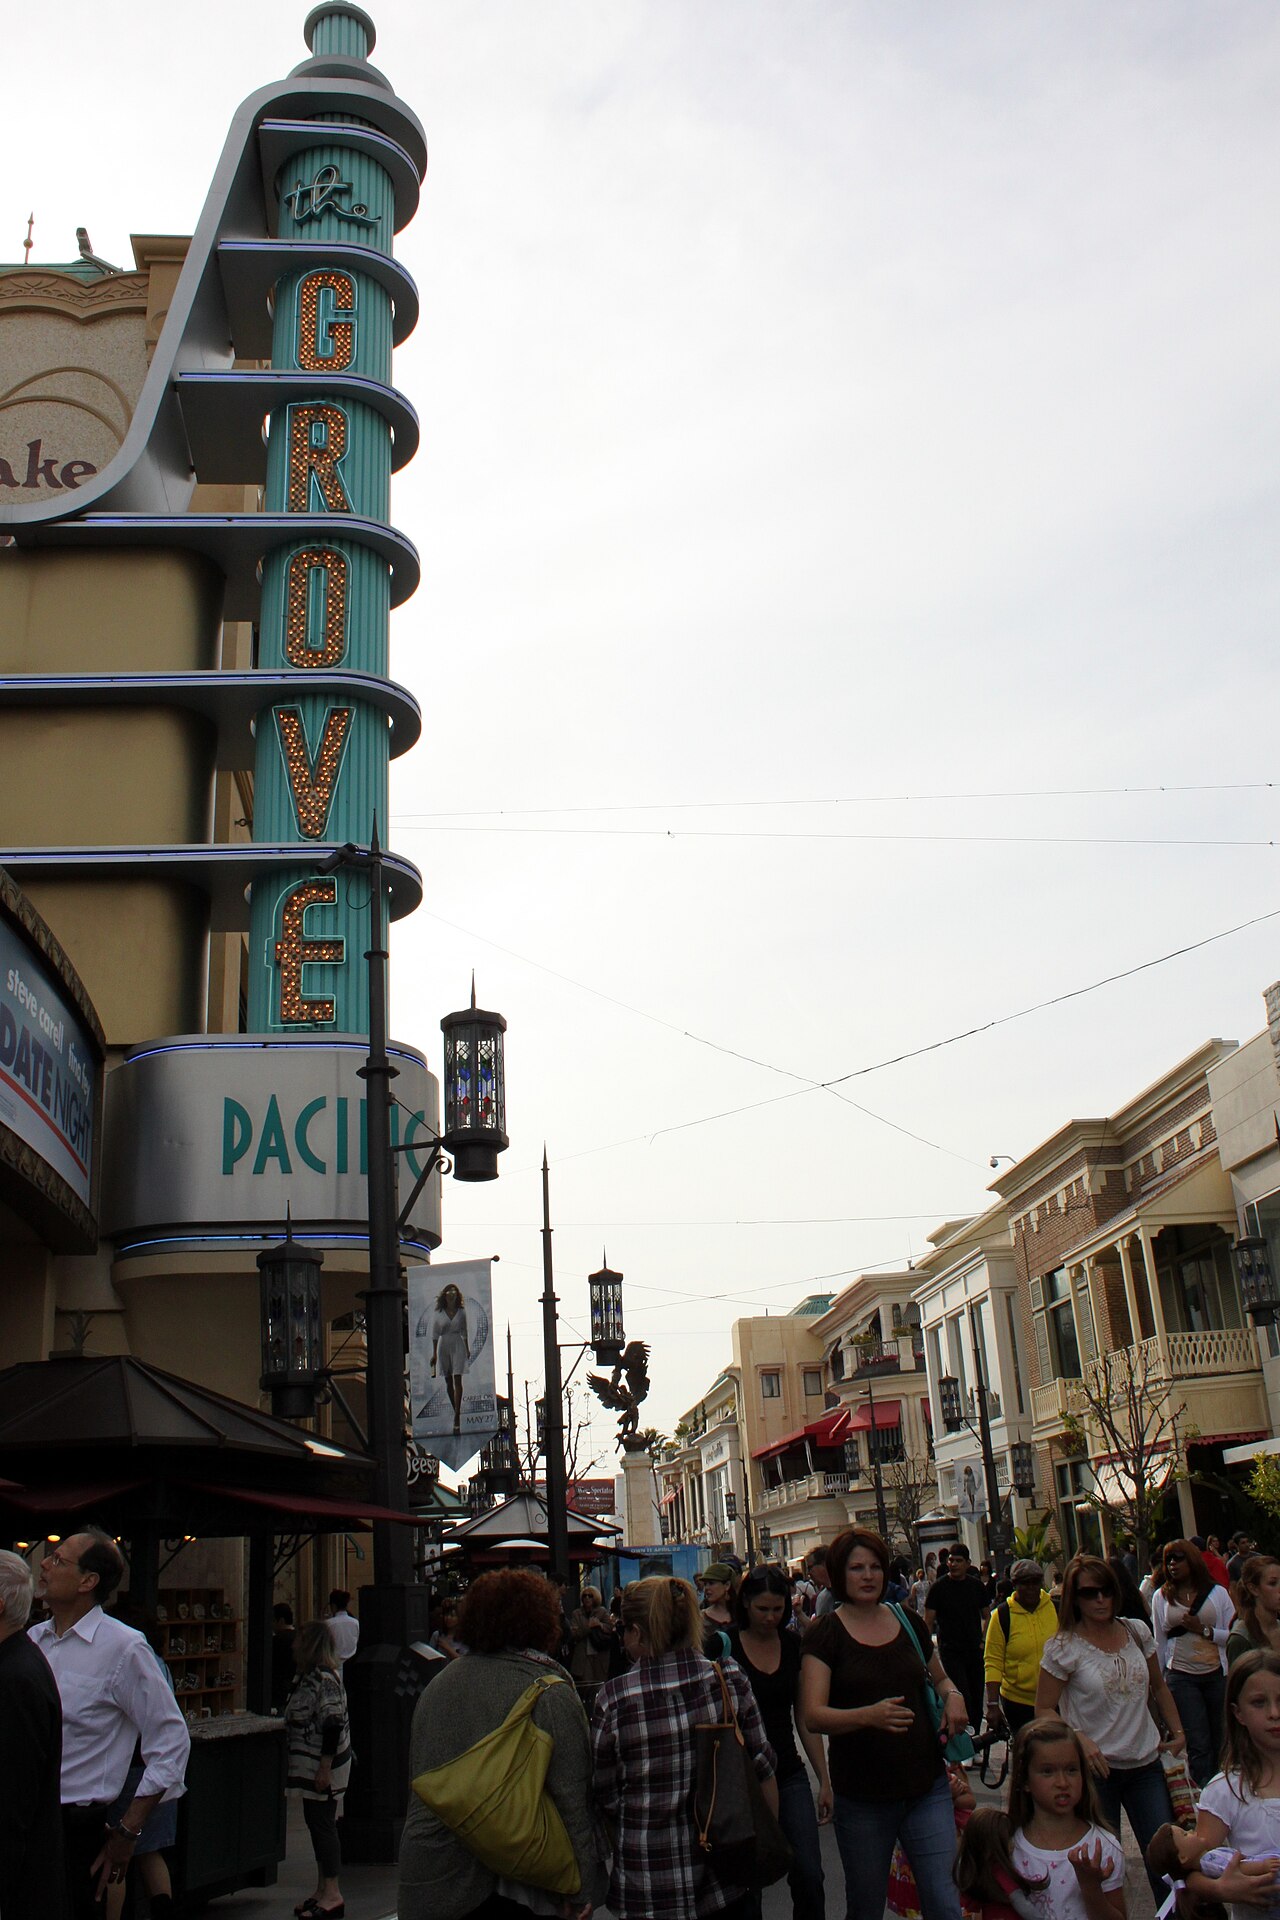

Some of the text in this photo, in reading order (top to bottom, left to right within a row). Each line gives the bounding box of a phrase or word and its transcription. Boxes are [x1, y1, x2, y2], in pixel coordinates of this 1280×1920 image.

[282, 165, 382, 225] the
[265, 267, 358, 1027] GROVE
[7, 968, 38, 1018] steve
[38, 1006, 65, 1055] carell
[0, 1001, 91, 1164] DATE NIGHT
[466, 1413, 494, 1425] MAY 27
